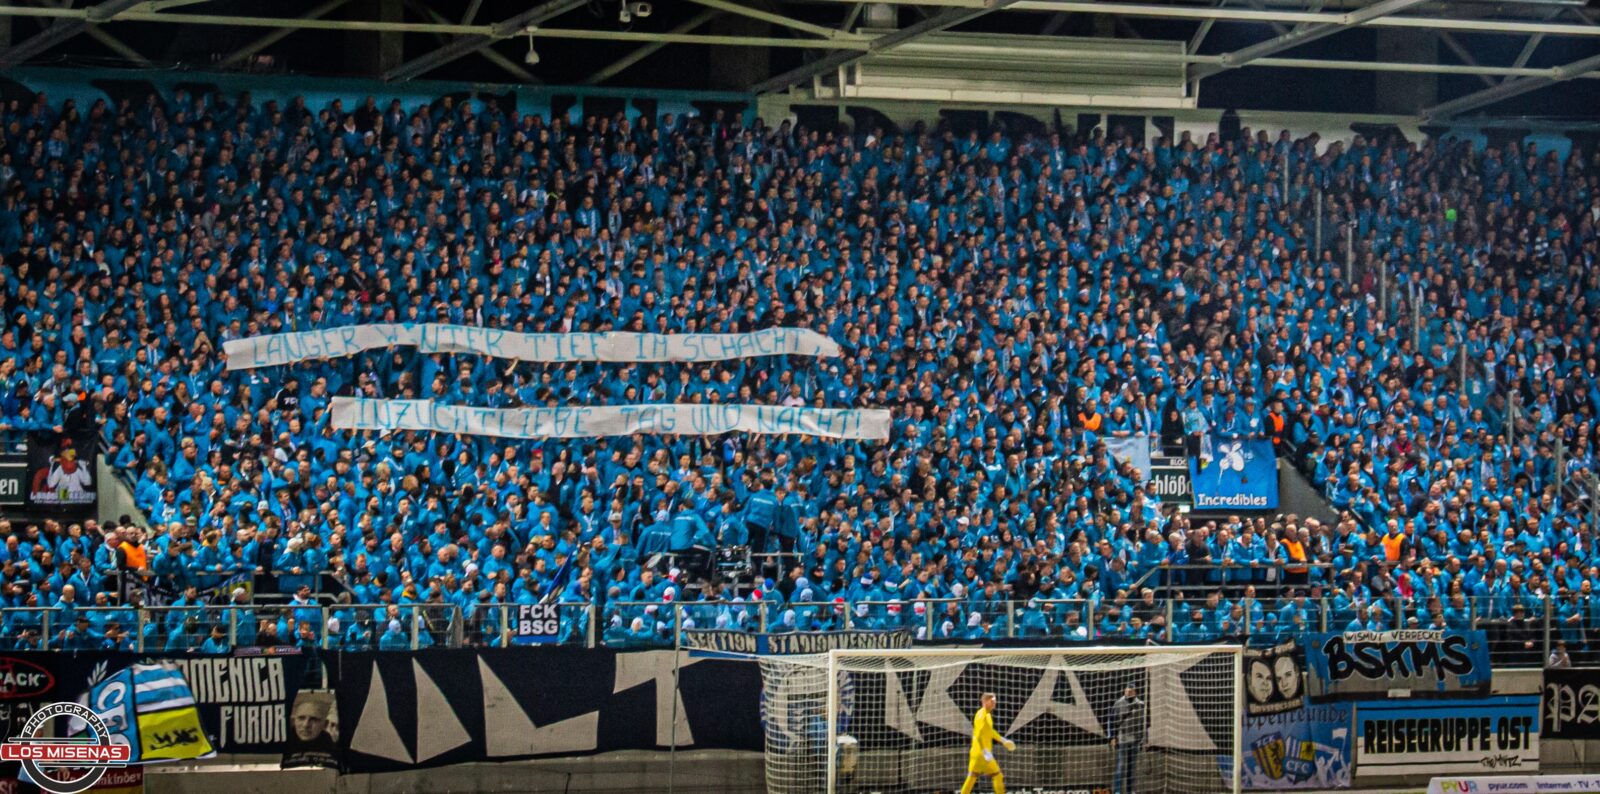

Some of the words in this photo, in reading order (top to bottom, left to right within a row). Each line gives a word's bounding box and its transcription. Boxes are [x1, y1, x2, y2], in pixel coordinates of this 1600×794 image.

[253, 327, 361, 364] LANGER
[374, 322, 505, 356] WNTER
[525, 331, 607, 361] TIEF
[635, 333, 668, 358] IM
[621, 406, 676, 431] TAG
[691, 404, 741, 431] UND
[0, 479, 18, 495] en
[1197, 493, 1268, 506] Incredibles
[520, 604, 558, 620] FCK
[519, 620, 558, 636] BSG
[1344, 631, 1384, 642] WISMUT
[1391, 630, 1442, 641] VERRECKE
[687, 631, 757, 652] SEKTION
[221, 704, 287, 748] FUROR
[1364, 718, 1491, 754] REISEGRUPPE
[1497, 716, 1533, 750] OST
[1440, 780, 1478, 792] PYUR
[1488, 782, 1529, 791] pyur.com
[1577, 780, 1589, 788] TV
